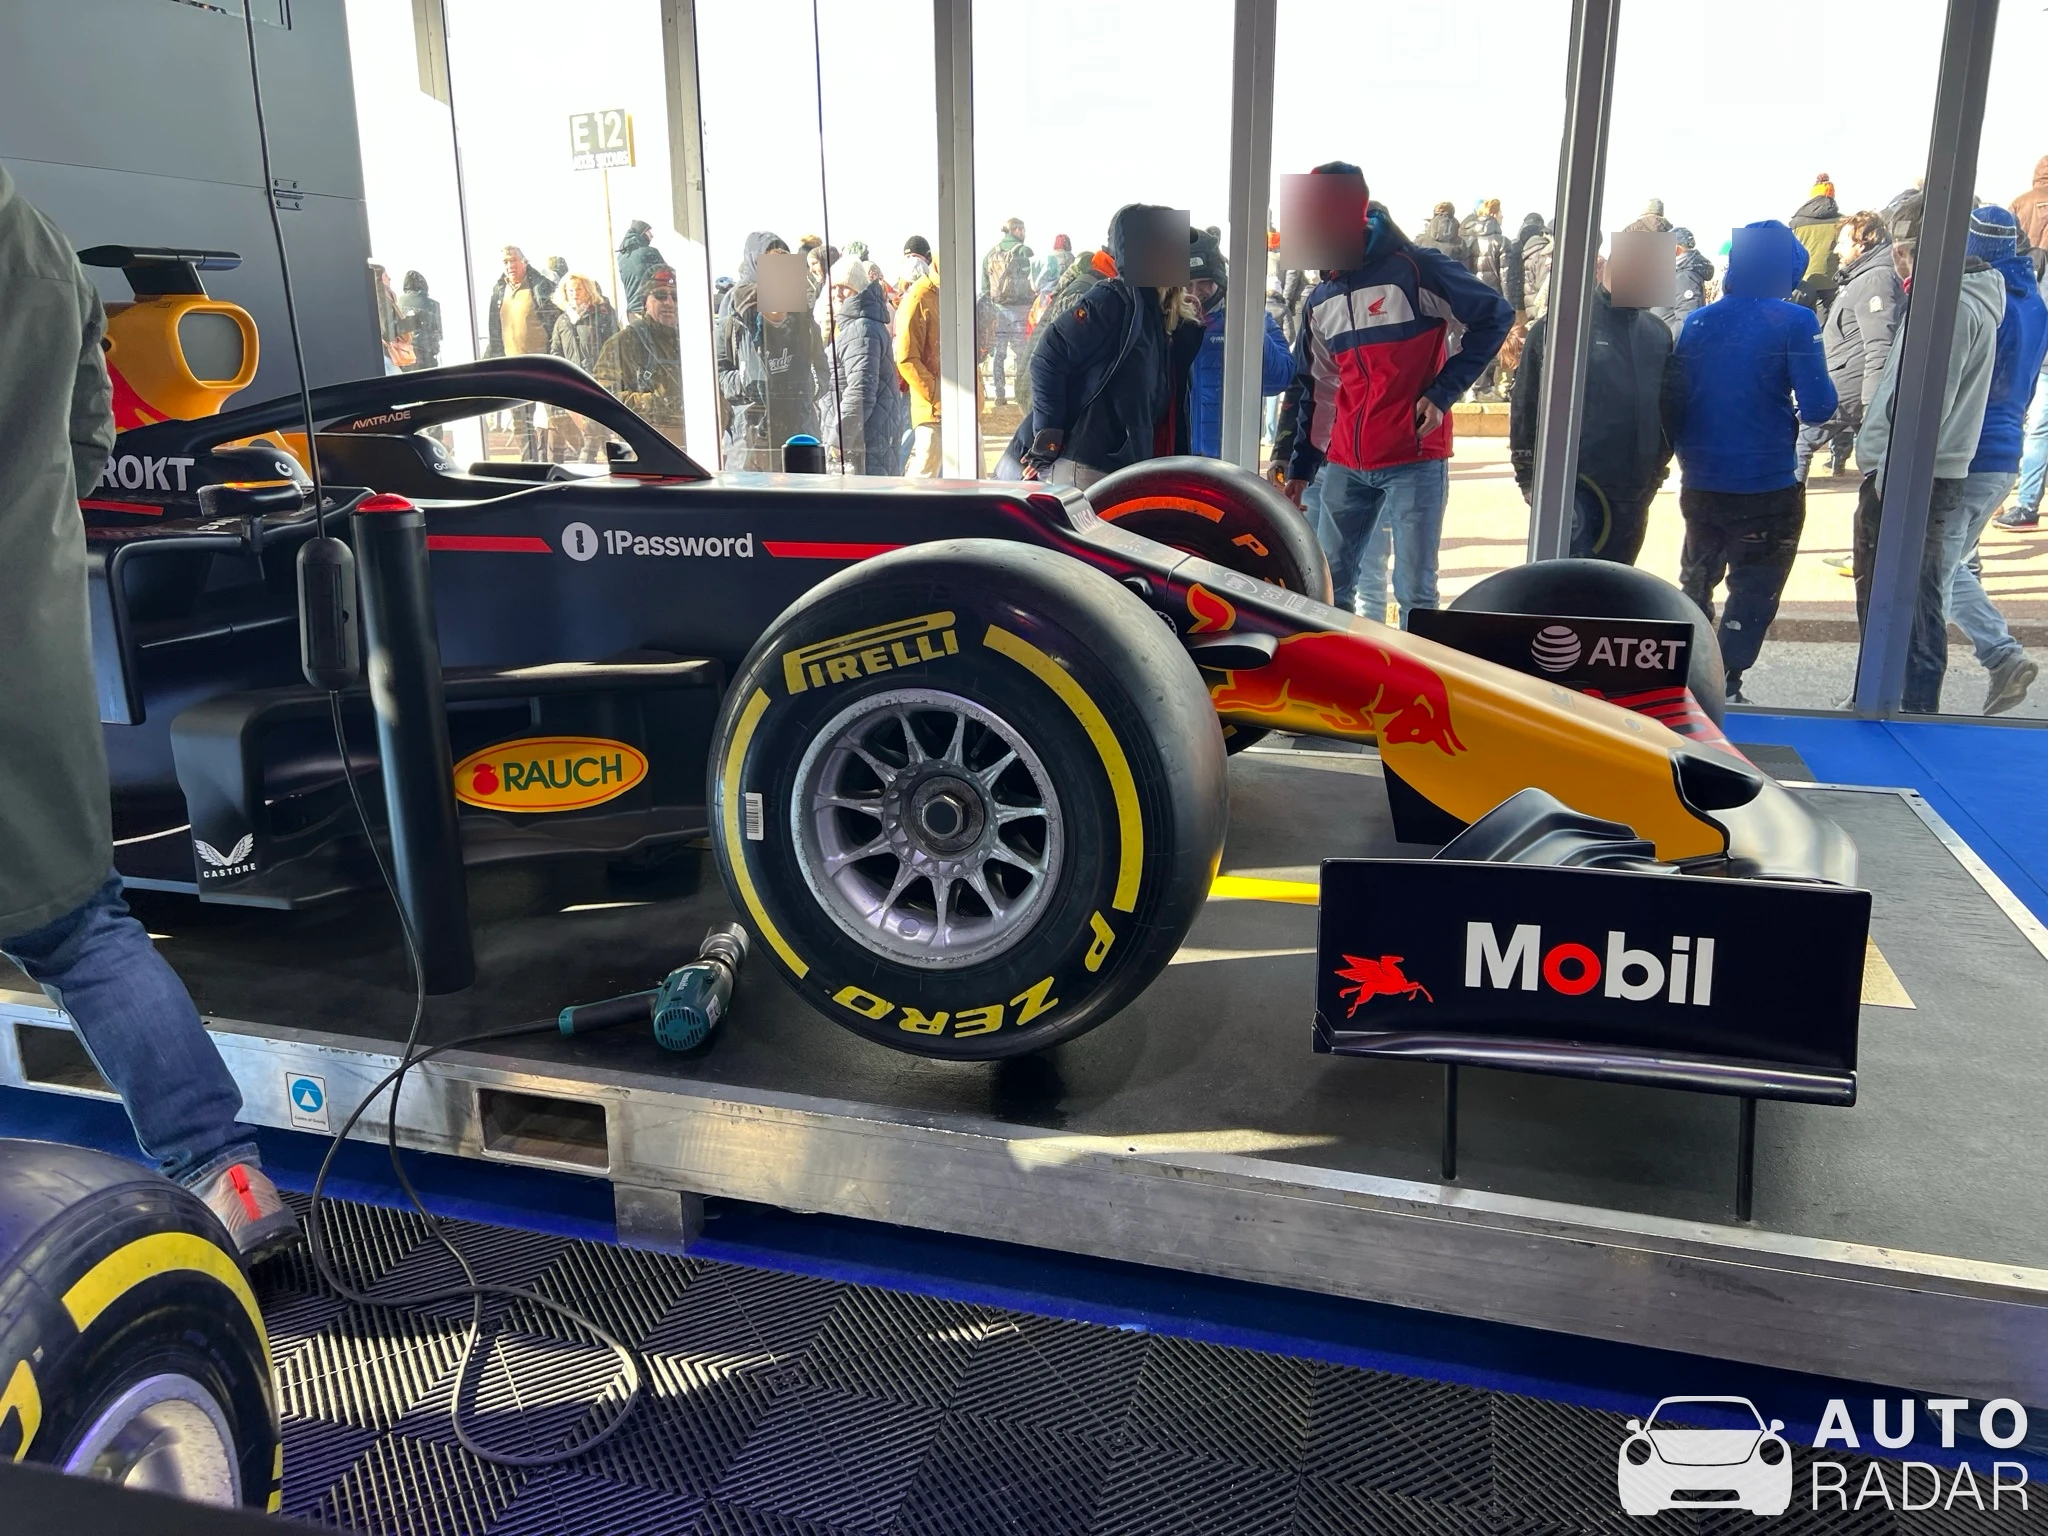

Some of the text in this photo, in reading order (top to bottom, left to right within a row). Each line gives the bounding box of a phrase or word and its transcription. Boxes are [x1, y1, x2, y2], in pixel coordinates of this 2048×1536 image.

[571, 110, 624, 152] E 12
[352, 410, 412, 430] AVATRADE
[96, 454, 195, 492] ROKT
[603, 529, 754, 558] 1Password
[782, 610, 960, 696] PIRELLI
[1587, 636, 1687, 671] AT&T
[503, 753, 623, 792] RAUCH
[203, 862, 257, 878] CASTORE
[832, 910, 1116, 1039] P ZERO
[1464, 921, 1715, 1006] Mobil
